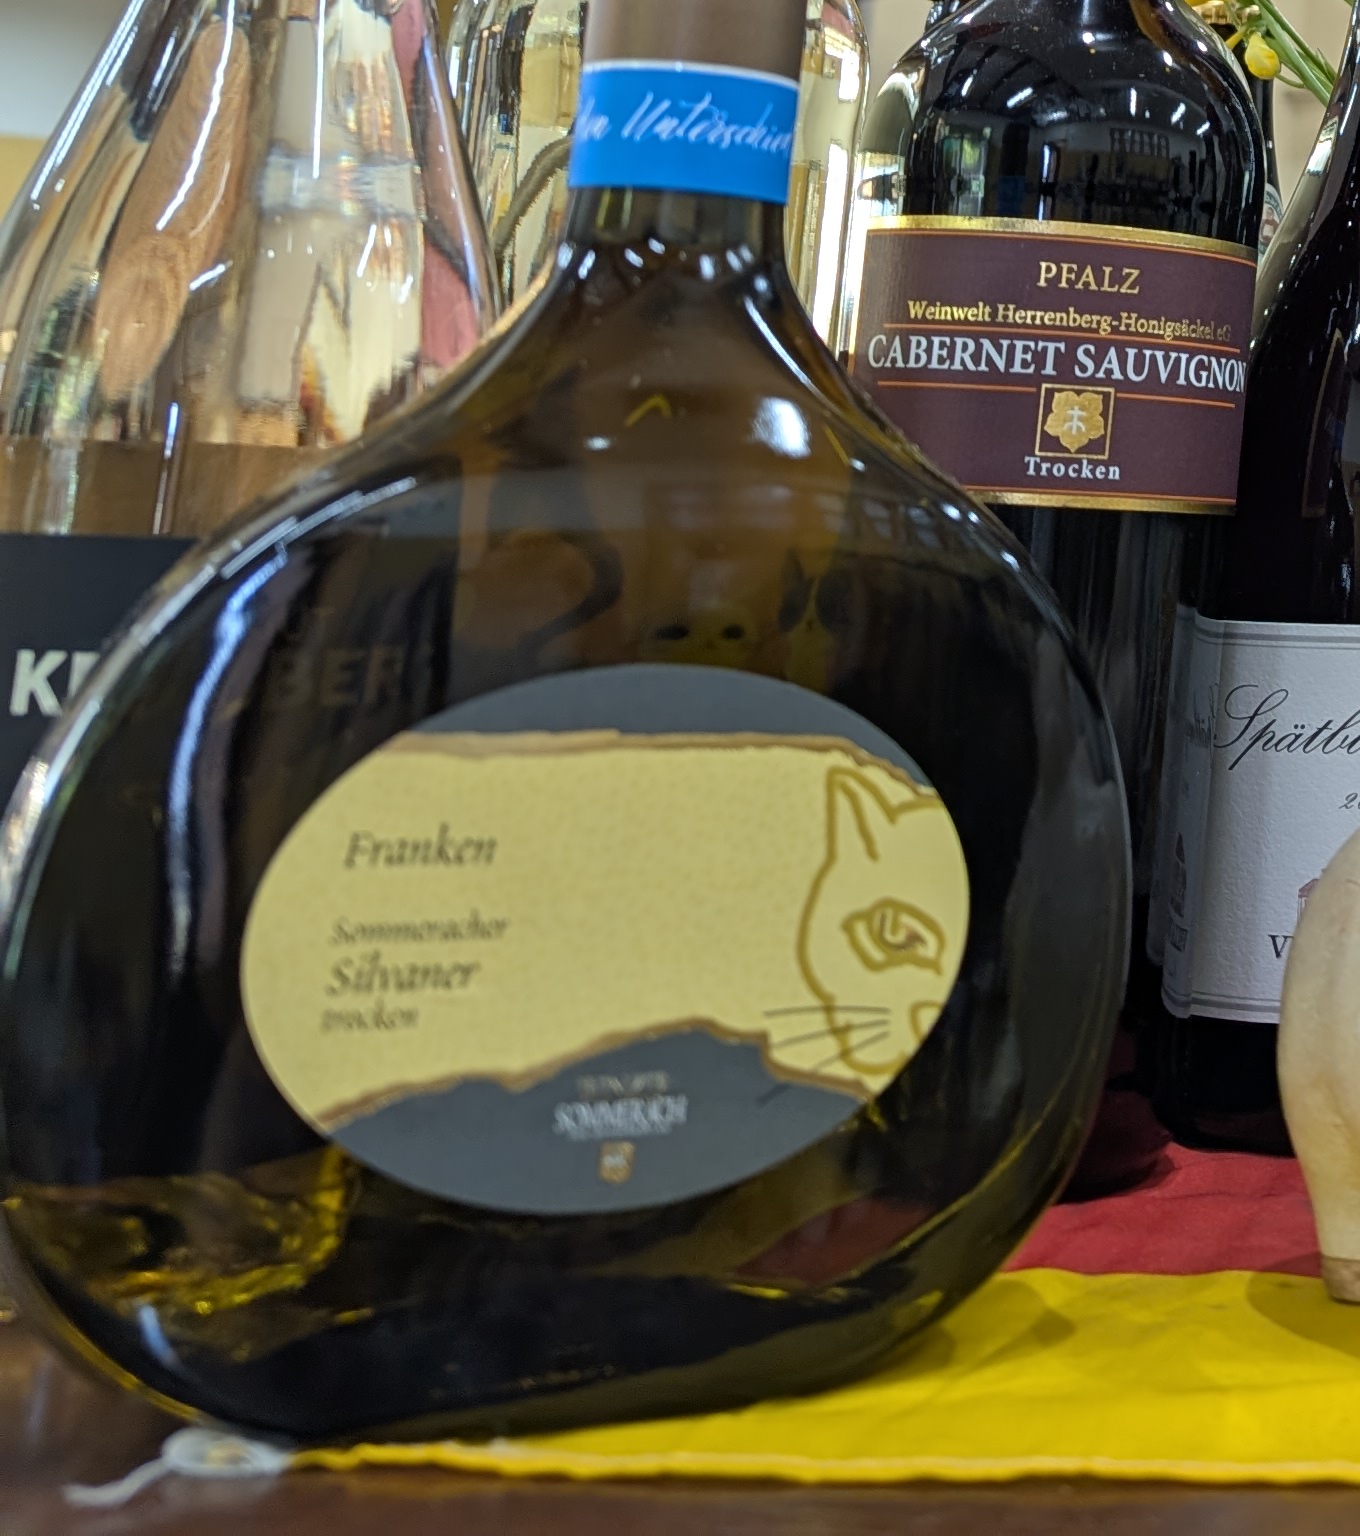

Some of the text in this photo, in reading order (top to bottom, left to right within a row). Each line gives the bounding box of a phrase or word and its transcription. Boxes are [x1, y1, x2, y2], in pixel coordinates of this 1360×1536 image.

[1036, 261, 1141, 295] PFALZ
[907, 300, 991, 323] Weinwelt
[997, 303, 1215, 342] Herrenberg-Honigsäckel
[867, 335, 1248, 394] CABERNET SAUVIGNON
[1024, 456, 1121, 481] Trocken
[345, 822, 498, 870] Franken
[329, 908, 509, 946] Sommeracher
[325, 949, 482, 996] Silvaner
